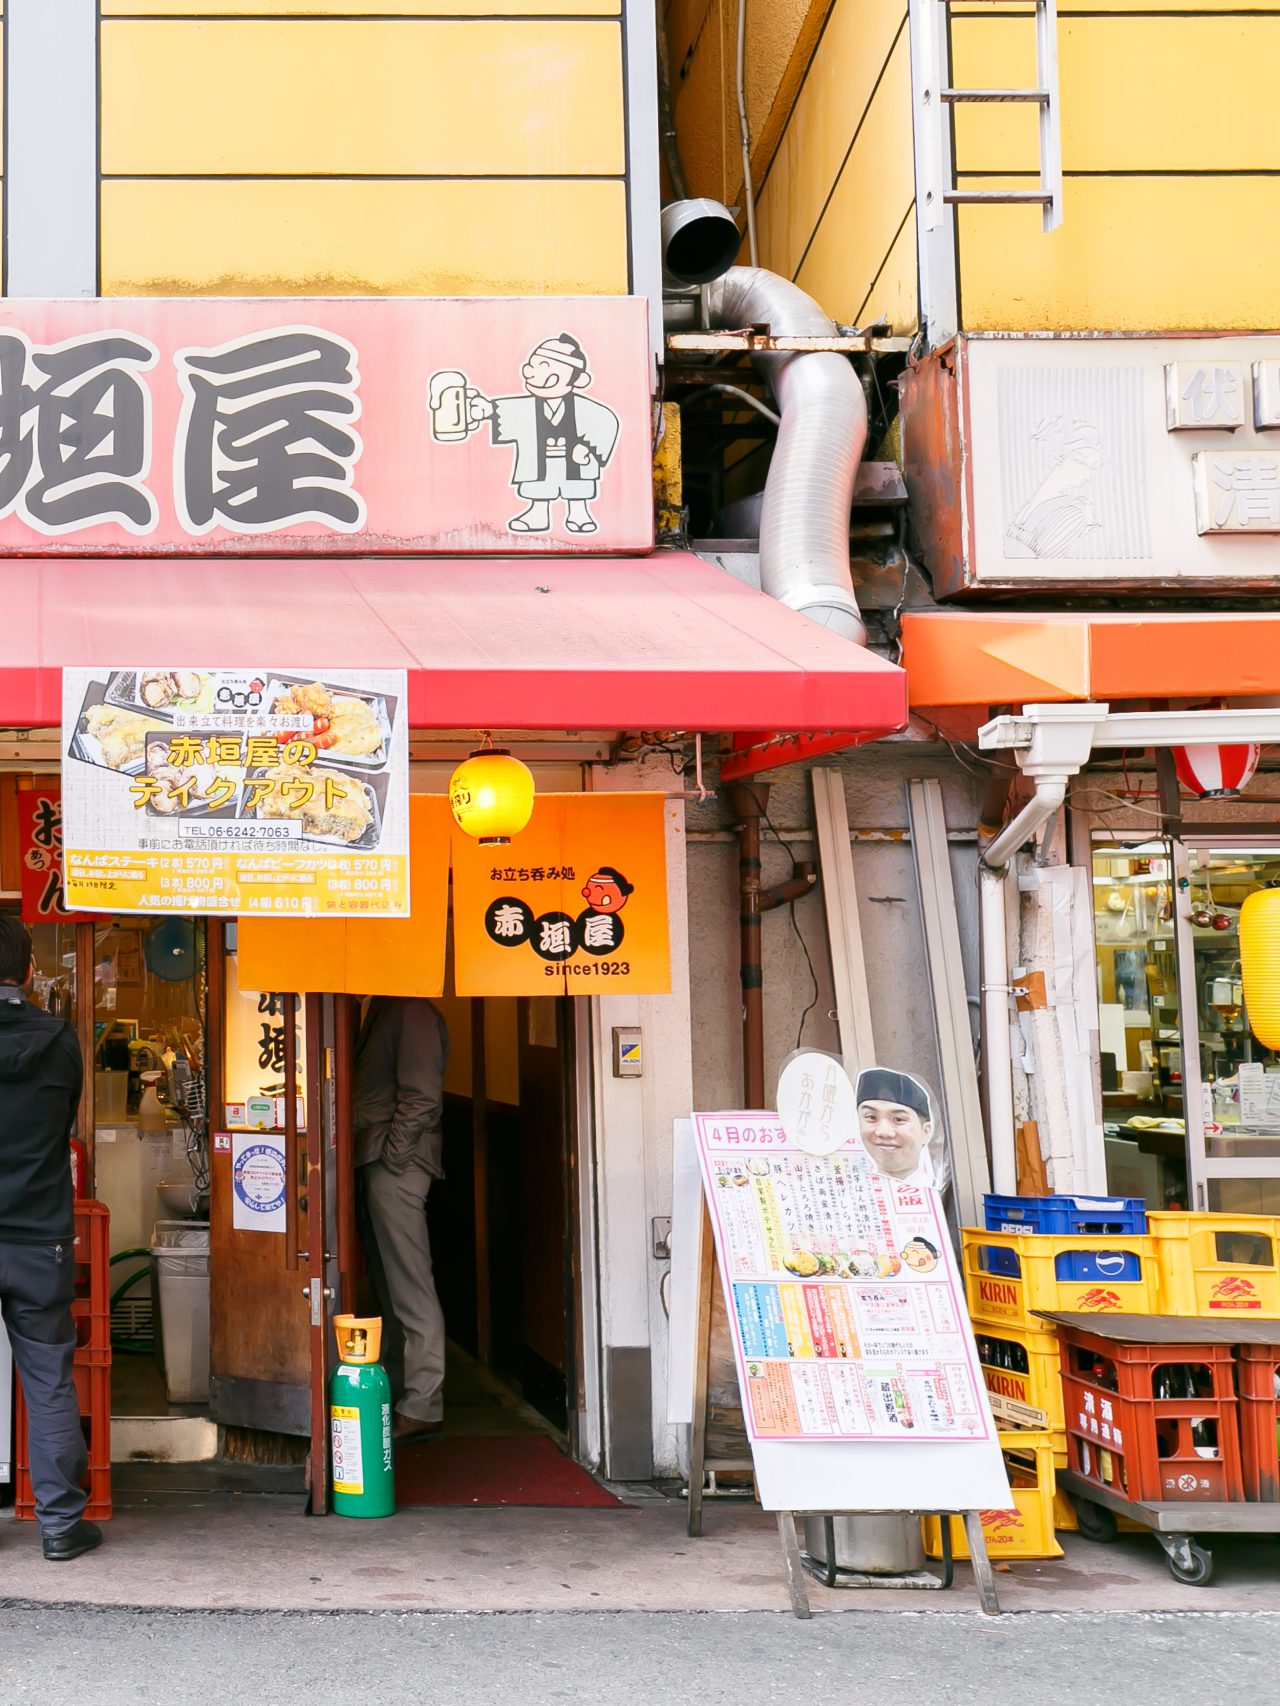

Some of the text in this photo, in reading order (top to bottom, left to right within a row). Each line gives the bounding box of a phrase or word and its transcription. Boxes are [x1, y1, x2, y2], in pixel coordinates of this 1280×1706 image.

[1183, 367, 1280, 422] 伏
[176, 715, 311, 728] 出来立て料理を楽々お渡し
[167, 735, 318, 768] 赤垣屋の
[129, 776, 348, 810] テイクアウト
[184, 826, 290, 838] TEL 06-6242-7063
[34, 799, 69, 914] おん
[70, 854, 159, 869] なんばステーキ
[490, 866, 576, 882] お立ち呑み処
[494, 904, 615, 954] 赤垣屋
[544, 962, 630, 976] since1923
[979, 1280, 1018, 1306] KIRIN
[987, 1372, 1026, 1402] KIRIN
